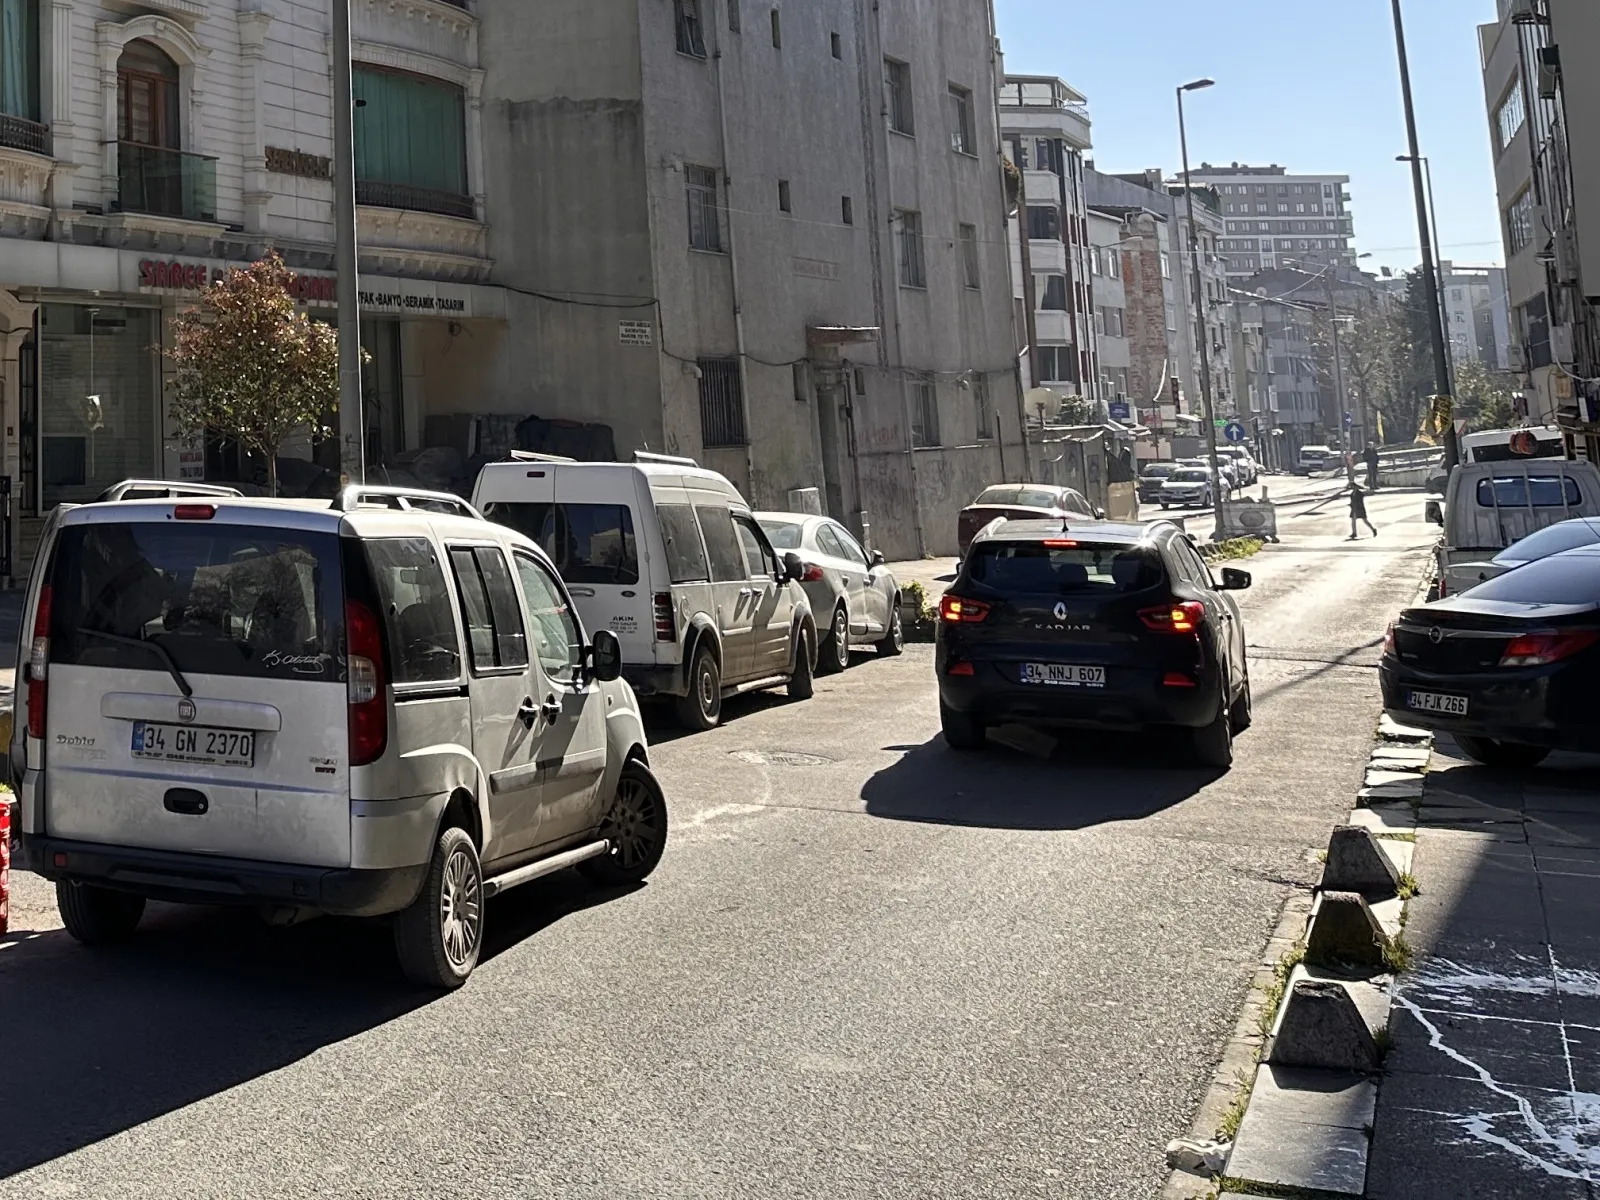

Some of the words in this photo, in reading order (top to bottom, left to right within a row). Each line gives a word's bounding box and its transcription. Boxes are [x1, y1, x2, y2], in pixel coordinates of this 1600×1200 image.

[358, 289, 374, 305] TFAK
[1035, 623, 1091, 631] KADJAR
[1026, 665, 1042, 678] 34
[1048, 666, 1073, 681] NNJ
[1079, 667, 1103, 682] 607
[1411, 693, 1422, 707] 34
[1424, 694, 1442, 710] FJK
[1444, 696, 1465, 713] 266
[145, 727, 165, 750] 34
[175, 730, 197, 753] GN
[206, 732, 250, 757] 2370
